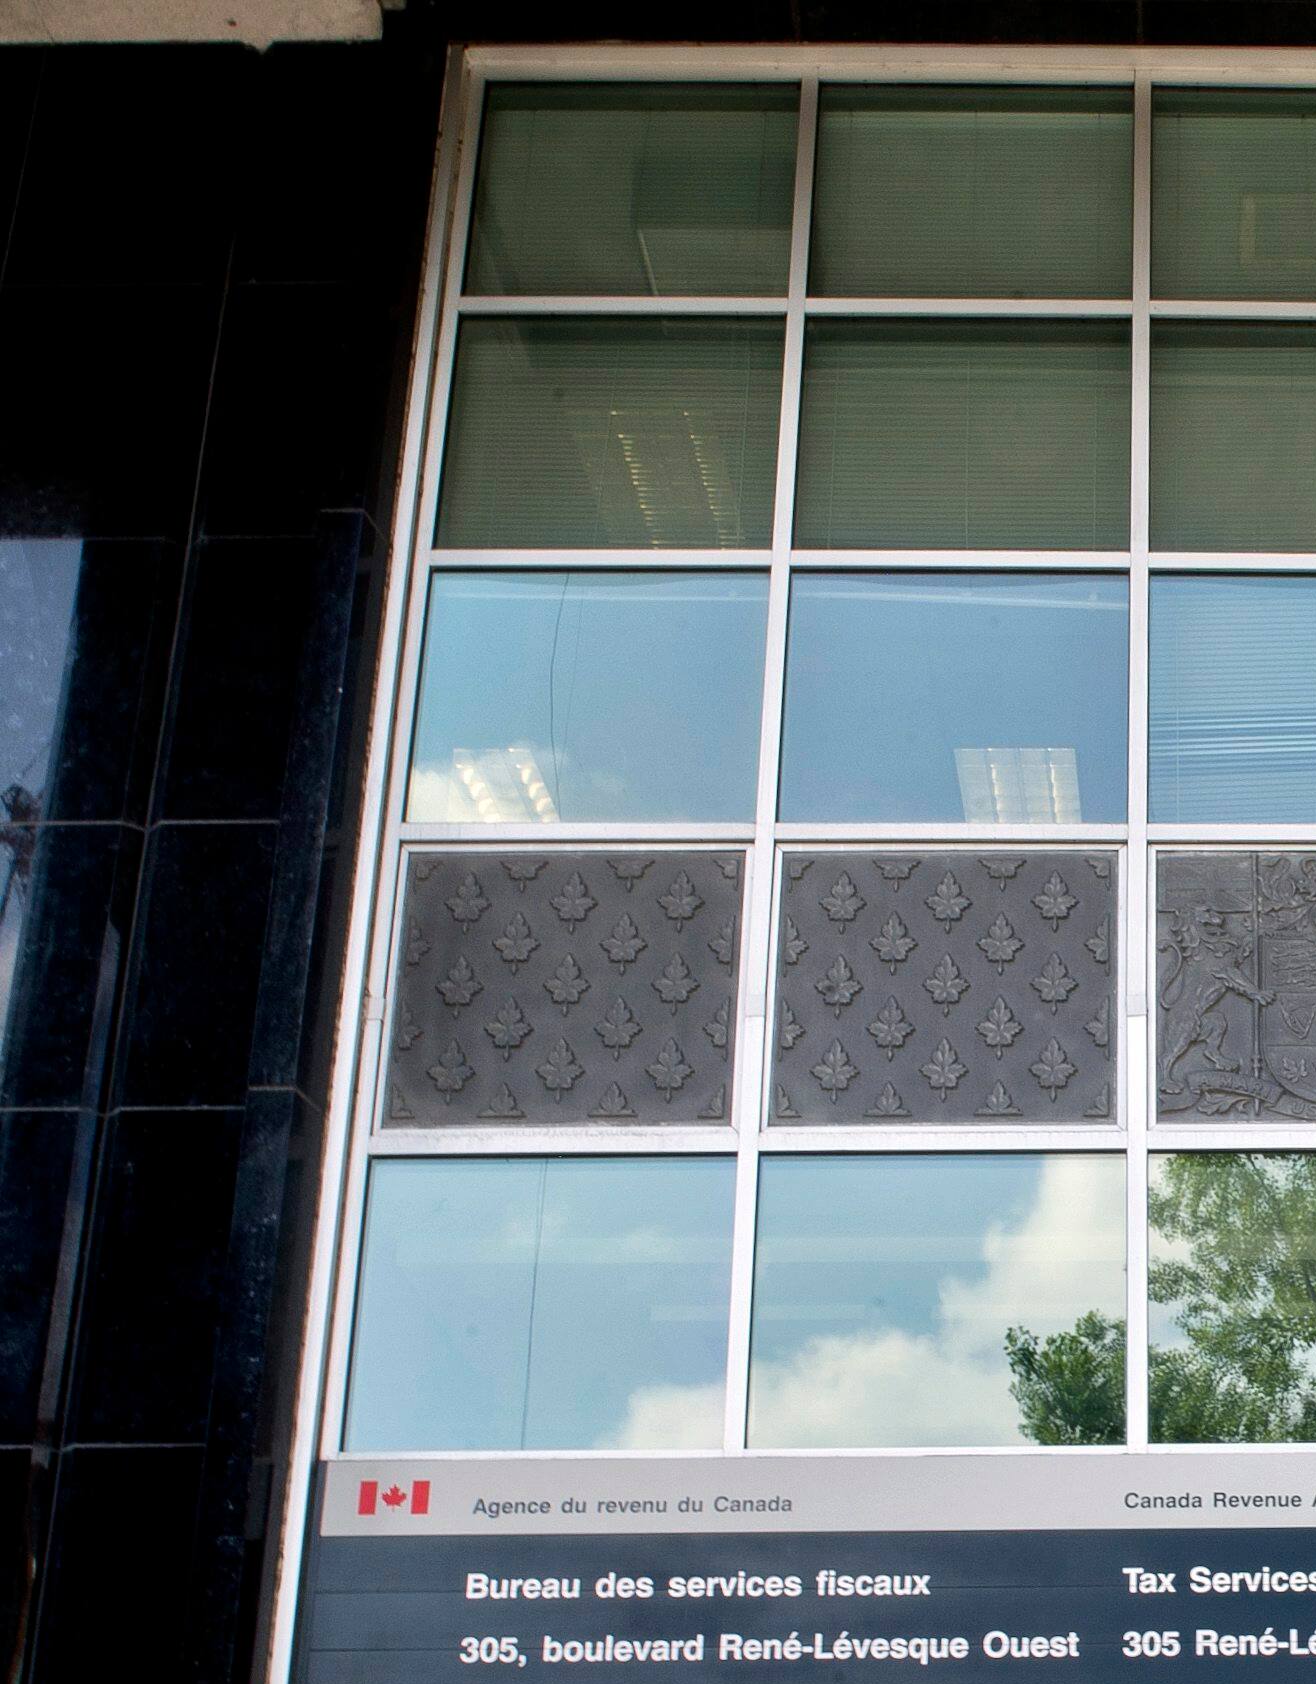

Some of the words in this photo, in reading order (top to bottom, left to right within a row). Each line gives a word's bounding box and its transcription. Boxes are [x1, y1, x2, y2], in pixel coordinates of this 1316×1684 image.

[472, 1498, 551, 1519] Agence
[561, 1497, 587, 1514] du
[597, 1500, 667, 1514] revenu
[677, 1496, 703, 1513] du
[713, 1495, 792, 1513] Canada
[1123, 1492, 1203, 1509] Canada
[1213, 1491, 1302, 1508] Revenue
[465, 1572, 581, 1600] Bureau
[594, 1571, 655, 1599] des
[667, 1570, 803, 1598] services
[815, 1569, 931, 1597] fiscaux
[1121, 1566, 1177, 1594] Tax
[459, 1636, 527, 1668] 305,
[542, 1633, 705, 1663] boulevard
[718, 1630, 970, 1666] René-Lévesque
[982, 1630, 1081, 1659] Ouest
[1121, 1630, 1182, 1658] 305
